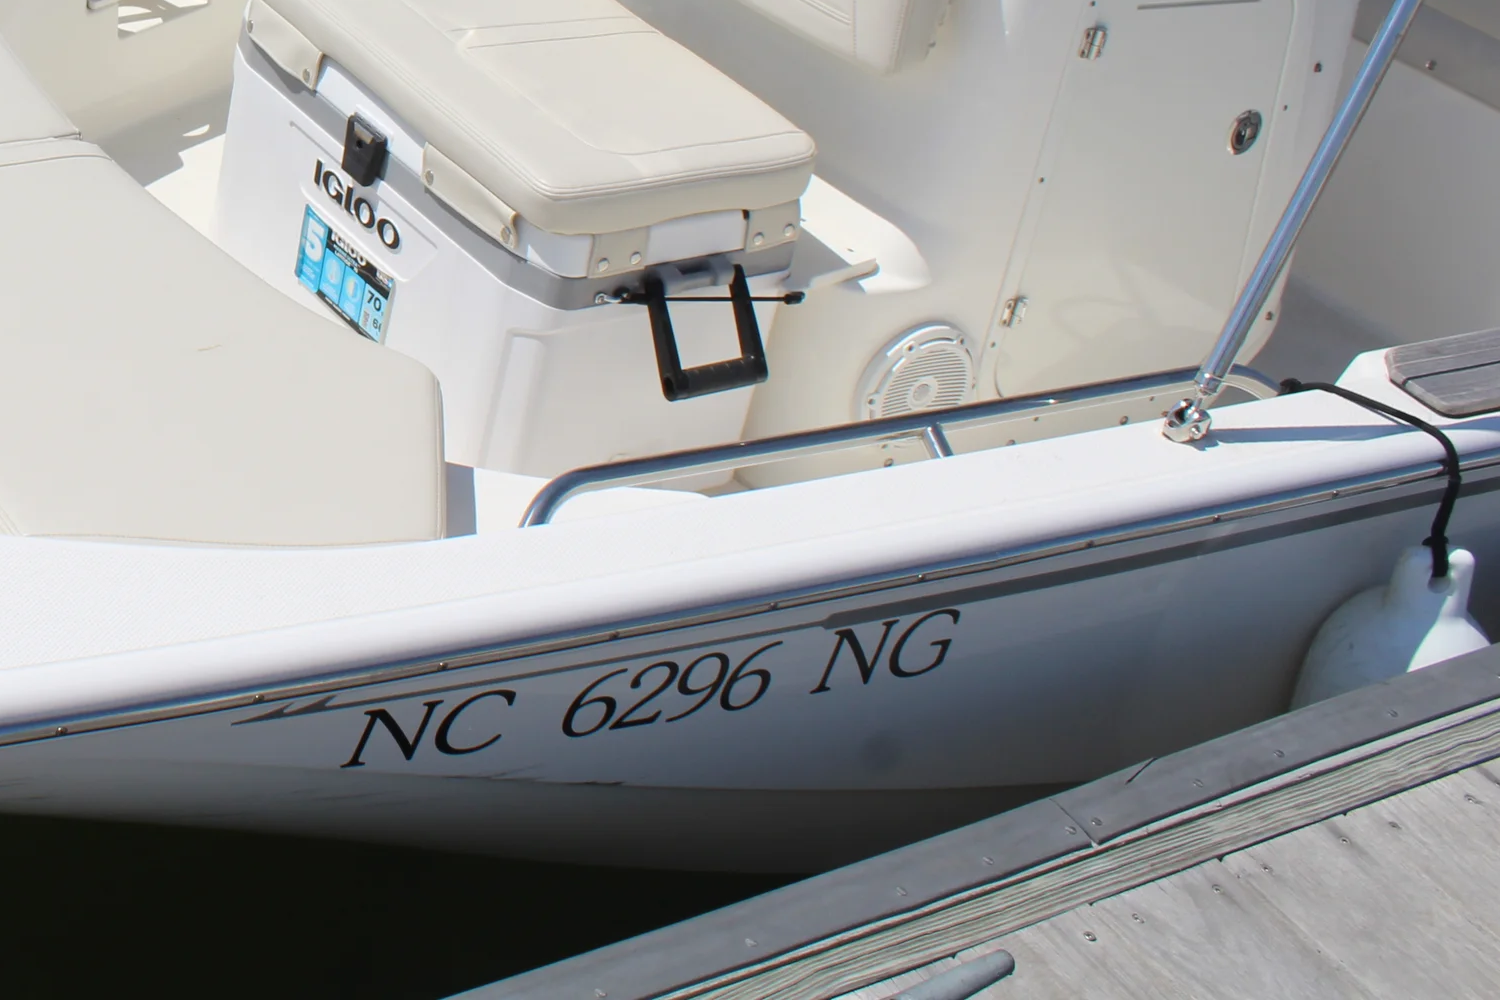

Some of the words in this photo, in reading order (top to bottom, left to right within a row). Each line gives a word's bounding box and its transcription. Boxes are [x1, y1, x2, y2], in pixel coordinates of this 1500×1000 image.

[313, 158, 400, 249] IGLOO
[304, 218, 326, 263] 5
[366, 289, 382, 311] 70
[340, 689, 517, 768] NC
[562, 640, 783, 738] 6296
[809, 608, 961, 694] NG
